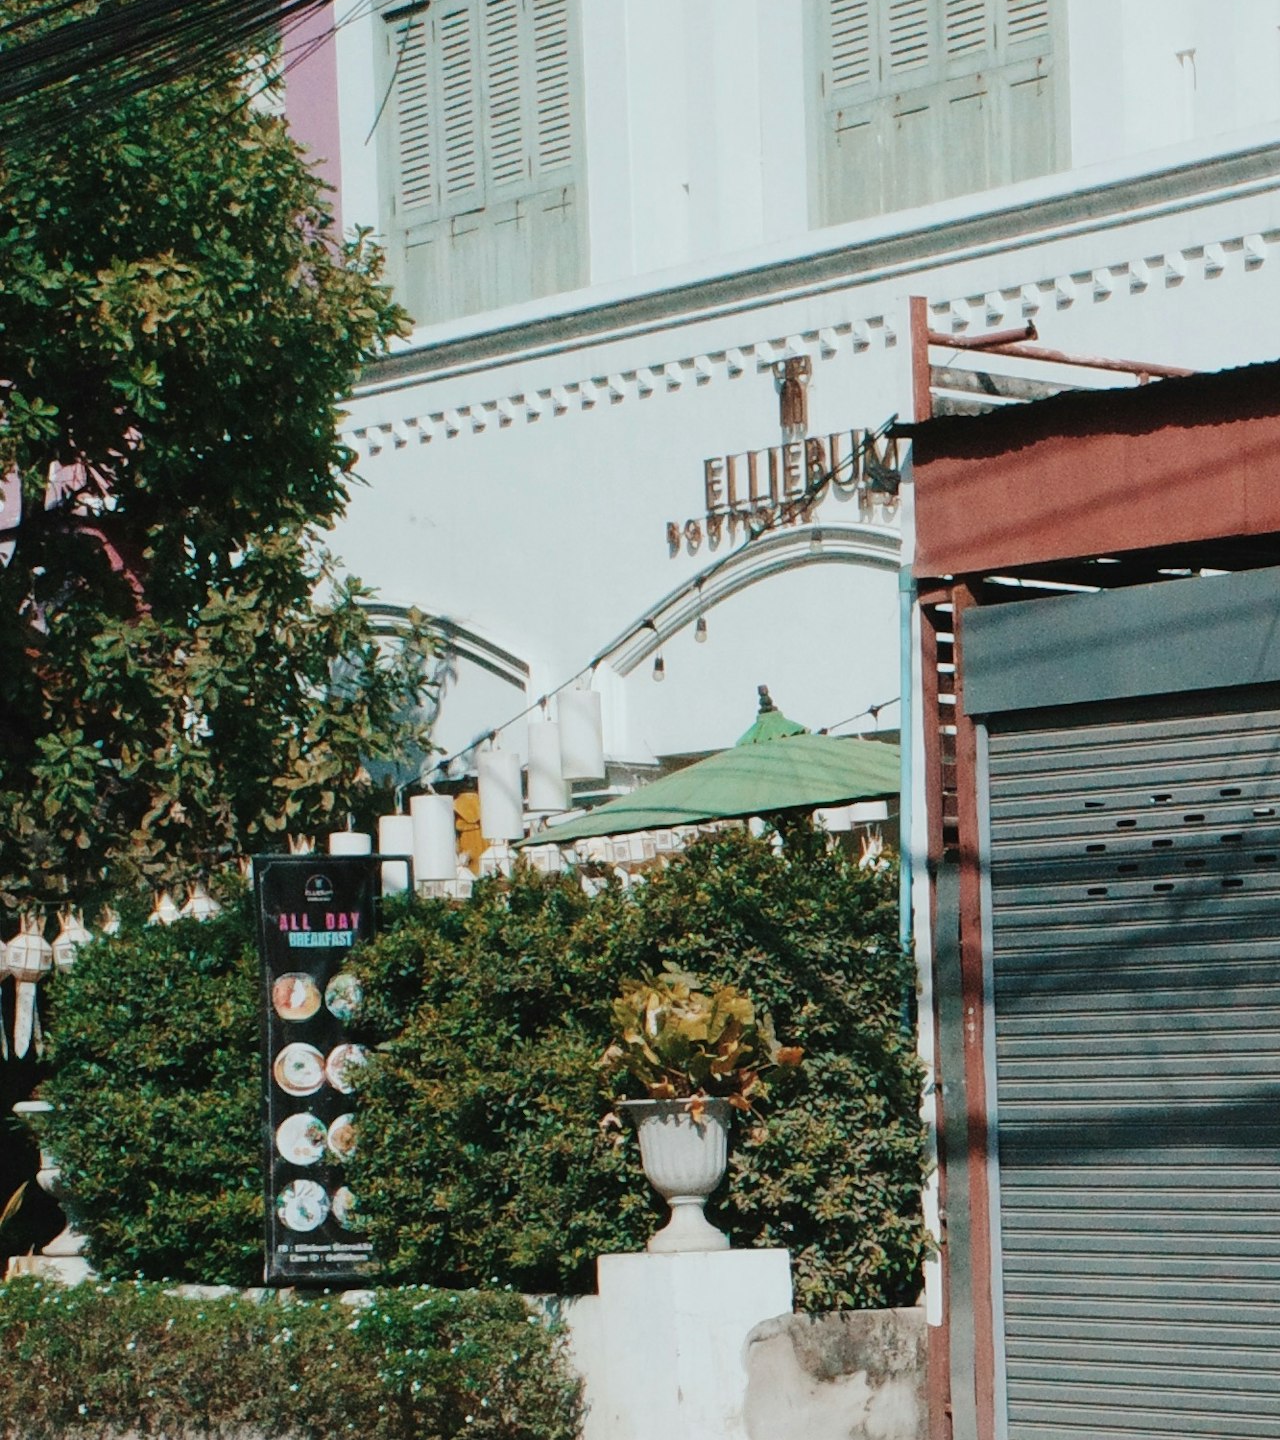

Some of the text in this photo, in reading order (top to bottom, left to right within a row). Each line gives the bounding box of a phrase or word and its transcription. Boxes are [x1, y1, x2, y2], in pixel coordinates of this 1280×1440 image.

[279, 912, 360, 931] ALL DAY
[288, 931, 353, 948] BREAKFAST
